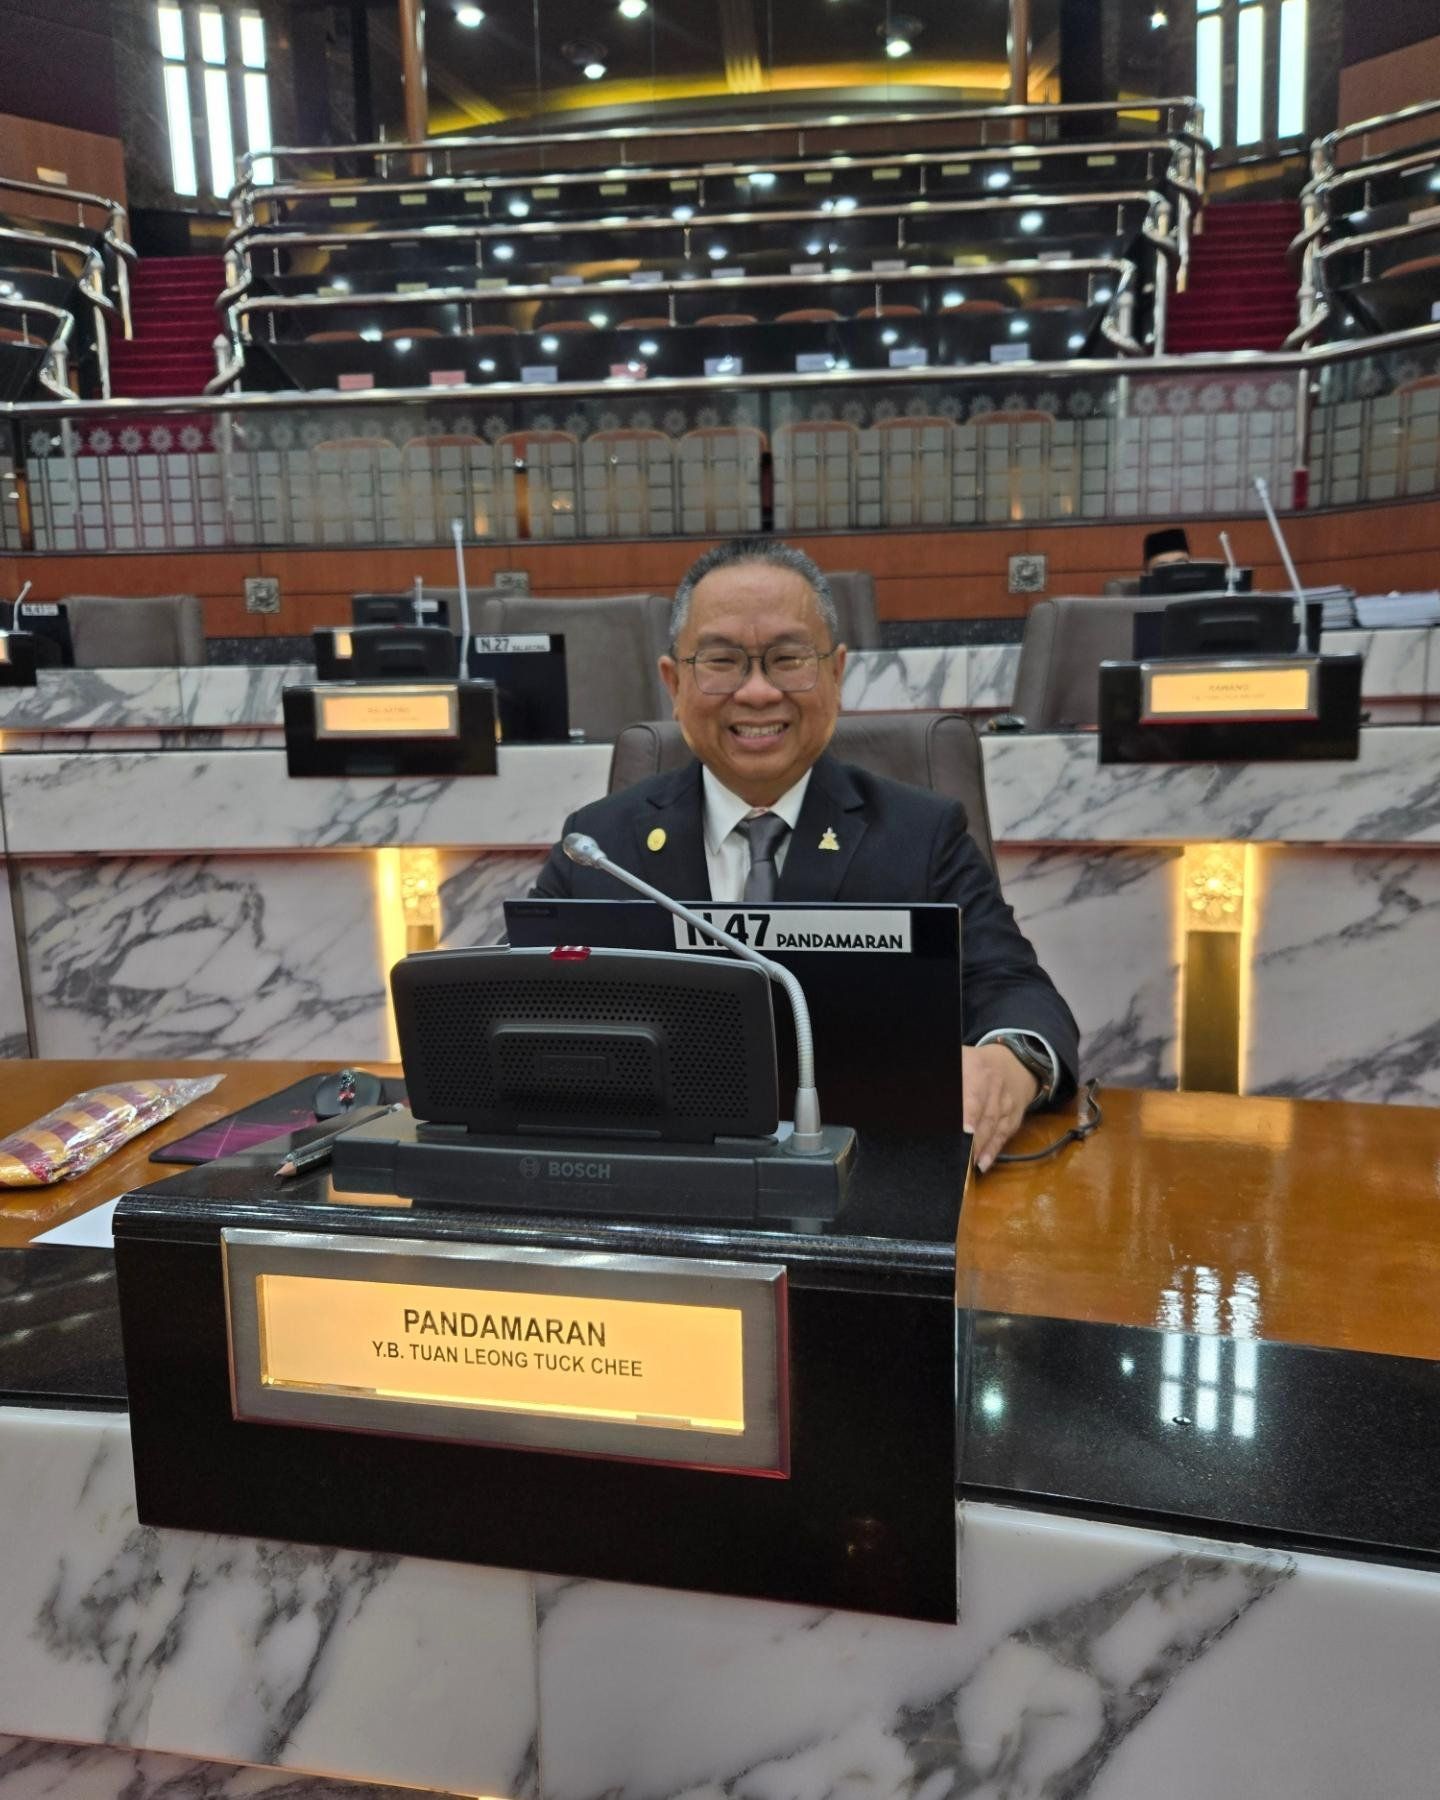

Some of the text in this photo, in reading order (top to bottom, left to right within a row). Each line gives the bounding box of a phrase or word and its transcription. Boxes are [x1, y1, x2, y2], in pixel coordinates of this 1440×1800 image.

[776, 933, 903, 949] PANDAMARAN
[548, 1161, 611, 1179] BOSCH
[403, 1308, 606, 1347] PANDAMARAN
[372, 1340, 643, 1377] Y.B. TUAN LEONG TUCK CHEE
